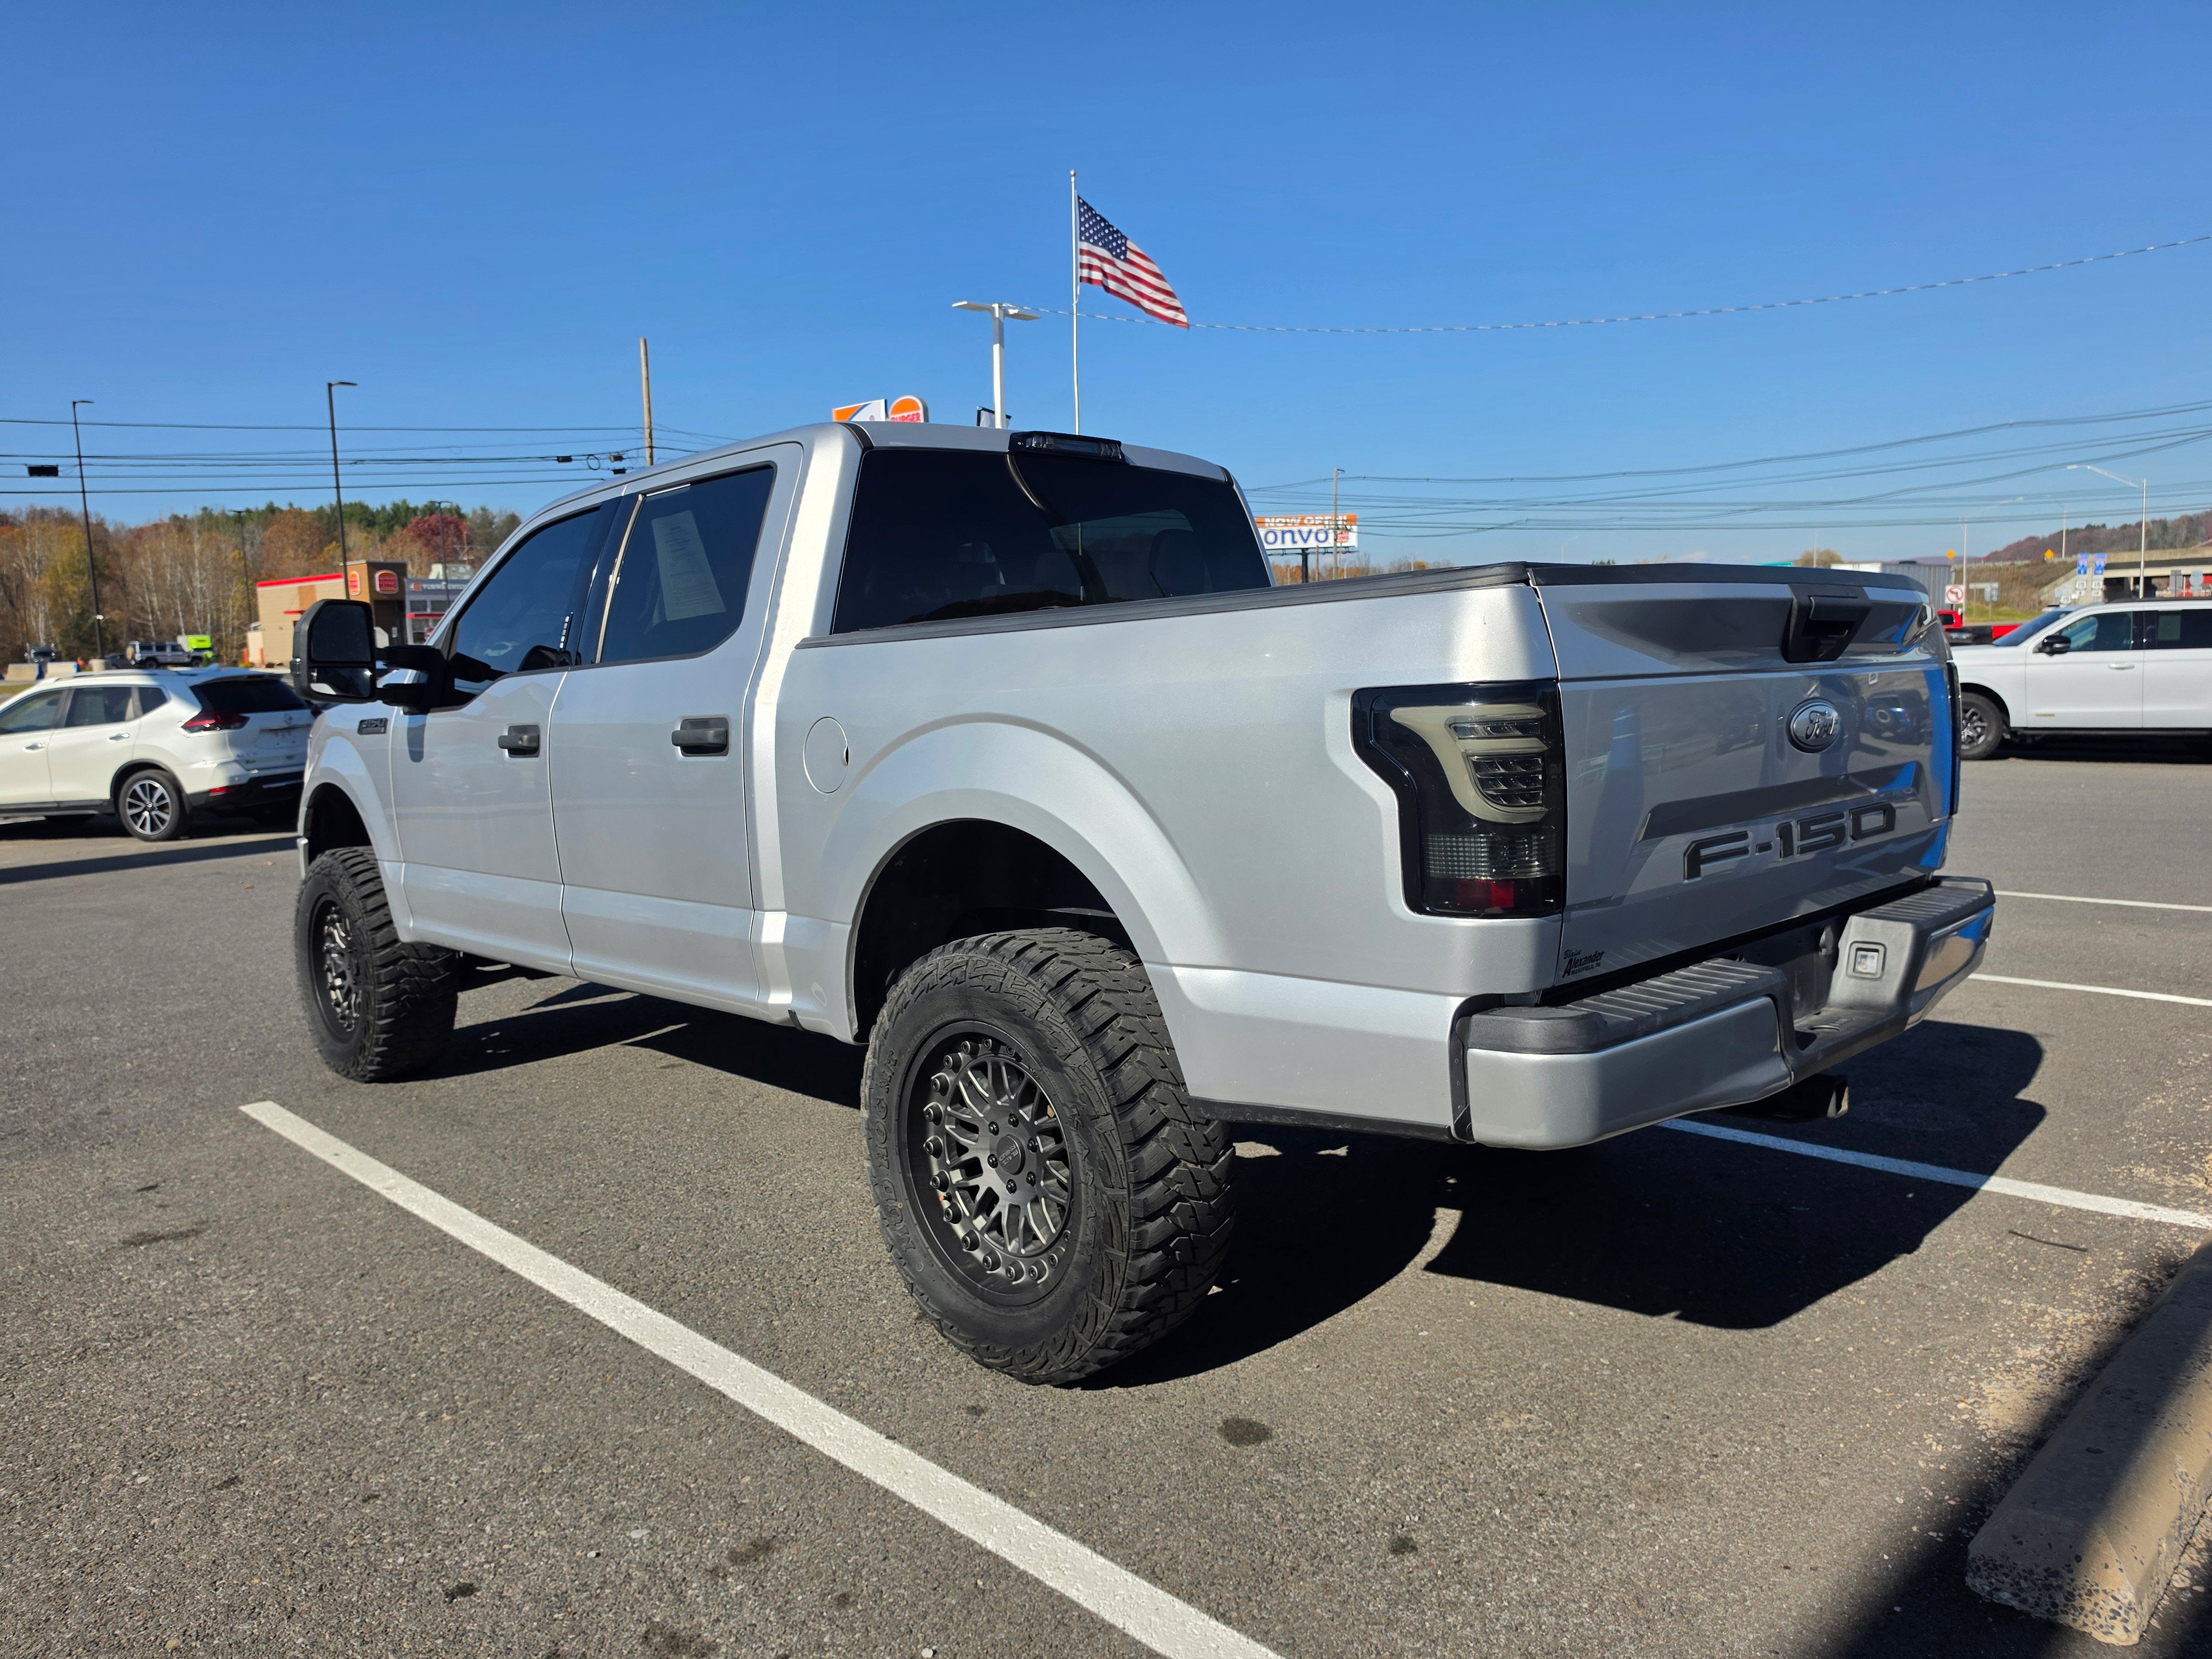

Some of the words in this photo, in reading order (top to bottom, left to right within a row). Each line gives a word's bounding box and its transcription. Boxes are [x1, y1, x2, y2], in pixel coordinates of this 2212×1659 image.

[1264, 517, 1301, 527] NOW
[1264, 528, 1329, 545] onvo
[1805, 710, 1836, 740] Ford
[1683, 803, 1896, 883] F-150
[1561, 950, 1605, 978] Alexander
[875, 1097, 890, 1170] HOG
